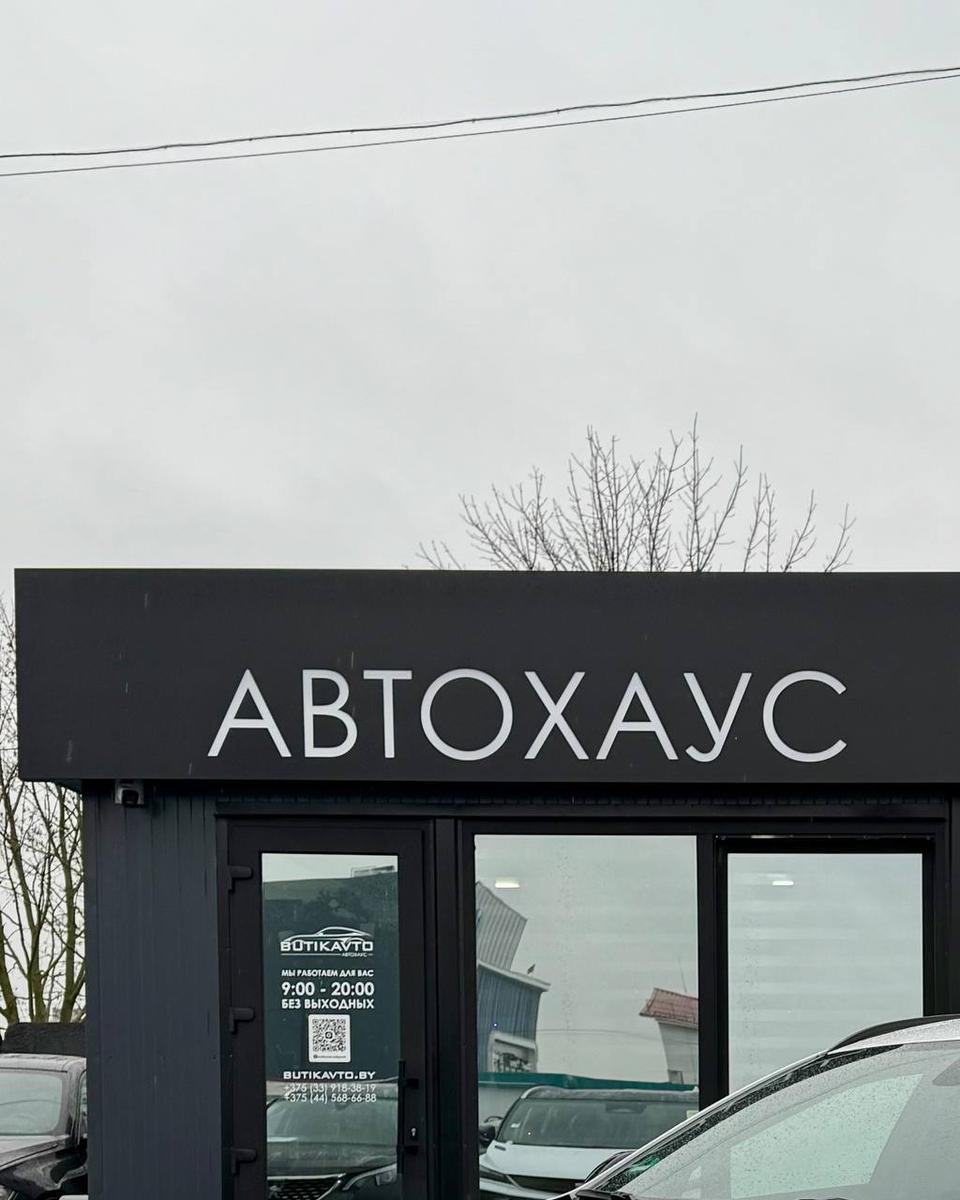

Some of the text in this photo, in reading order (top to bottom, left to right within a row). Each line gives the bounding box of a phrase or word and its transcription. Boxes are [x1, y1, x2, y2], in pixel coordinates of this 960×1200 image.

[207, 668, 847, 763] АВТОХАУС
[280, 940, 374, 952] BUTIKAVTO
[281, 969, 374, 978] МЫ РАБОТАЕМ ДЛЯ ВАС
[281, 981, 315, 996] 9:00
[331, 981, 375, 996] 20:00
[281, 998, 375, 1010] БЕЗ ВЫХОДНЫХ
[283, 1071, 376, 1080] BUTIKAVTO.BY
[310, 1082, 327, 1094] (33)
[331, 1083, 377, 1093] 918-38-19
[310, 1093, 327, 1104] (44)
[331, 1093, 377, 1103] 568-66-88
